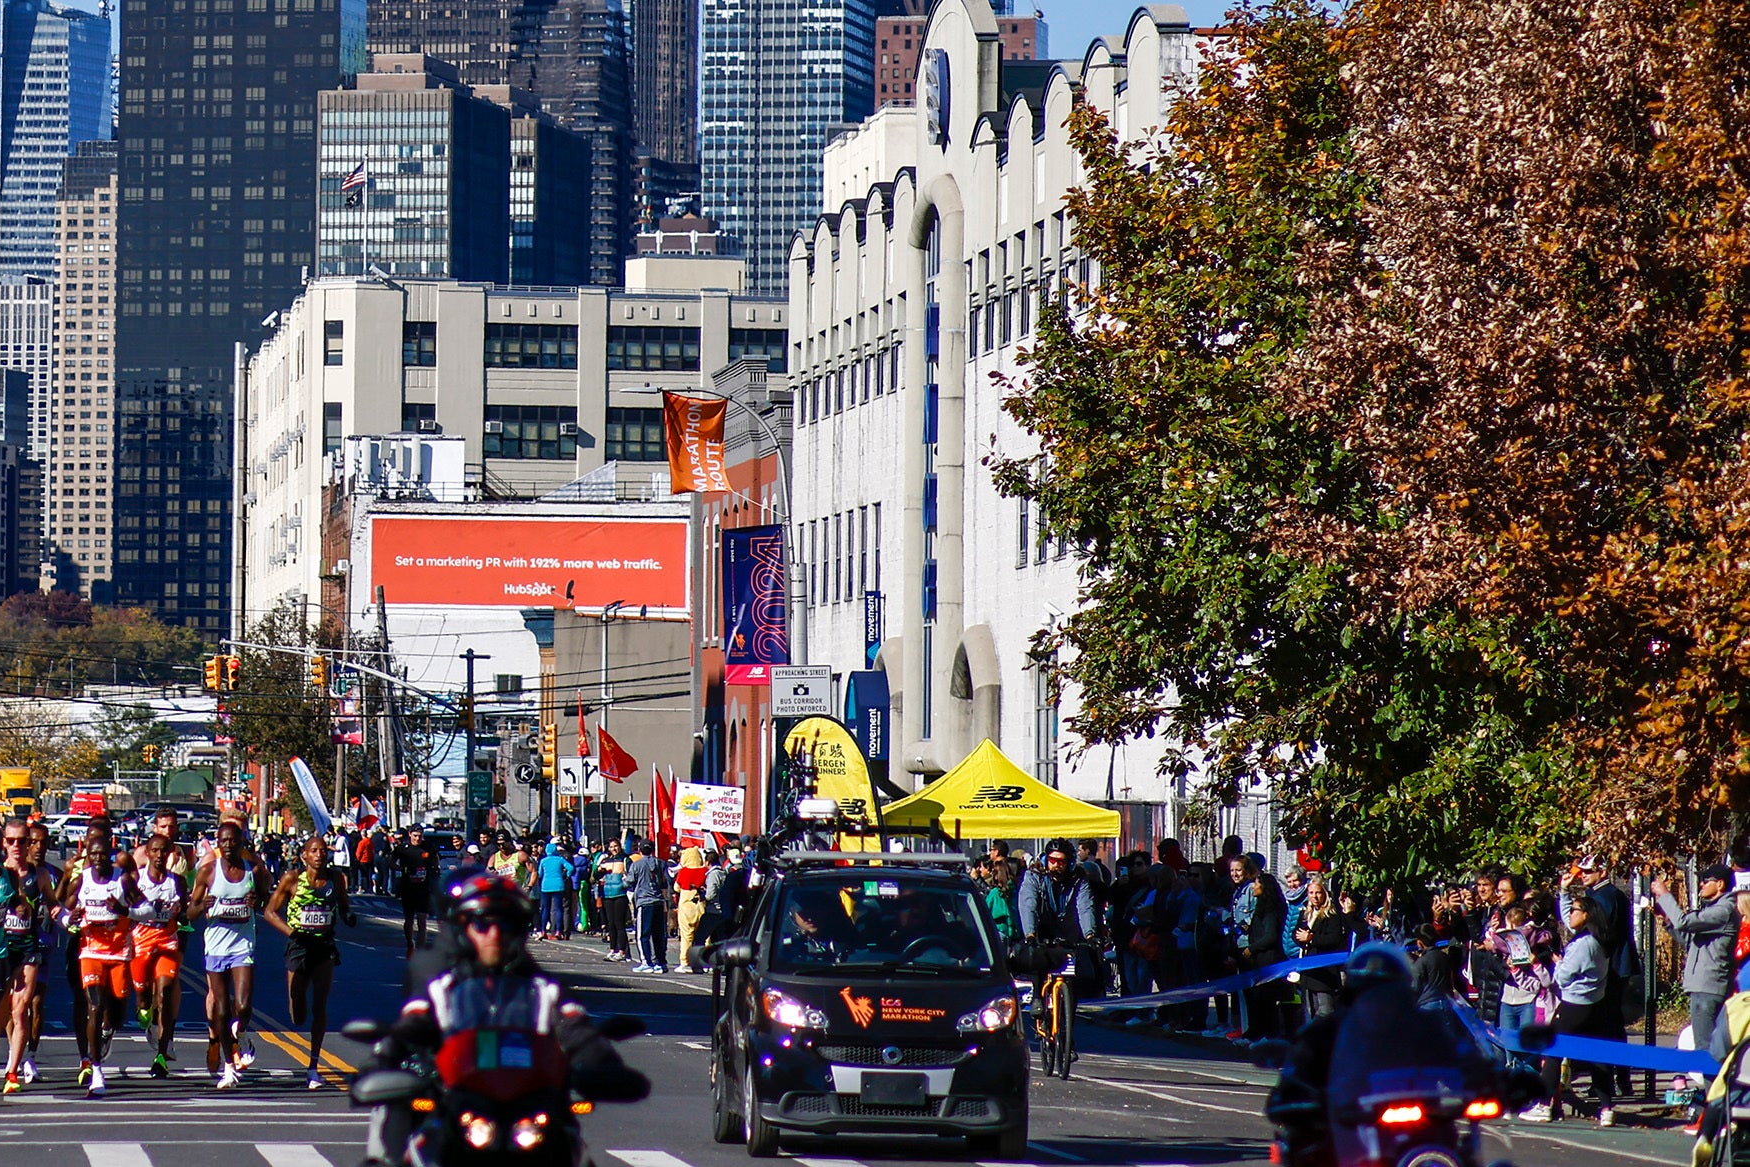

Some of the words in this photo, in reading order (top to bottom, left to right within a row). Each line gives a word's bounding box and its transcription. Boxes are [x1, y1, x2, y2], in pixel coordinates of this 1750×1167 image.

[685, 401, 708, 492] MARATHON
[706, 438, 727, 491] ROUTE
[395, 556, 413, 566] Set
[426, 556, 483, 569] marketing
[485, 557, 501, 567] PR
[503, 557, 527, 568] with
[529, 558, 560, 568] 192%
[563, 560, 593, 568] more
[596, 559, 621, 569] web
[623, 559, 662, 569] traffic.
[504, 582, 554, 596] HubSpot
[750, 536, 787, 663] 2024
[867, 595, 875, 642] movement
[868, 708, 877, 758] movement
[813, 758, 846, 767] BERGEN
[712, 811, 741, 820] POWER
[712, 819, 740, 827] BOOST
[222, 906, 249, 917] KORIR
[5, 917, 29, 927] OUNG
[304, 914, 329, 923] KIBET
[881, 998, 902, 1006] tcs
